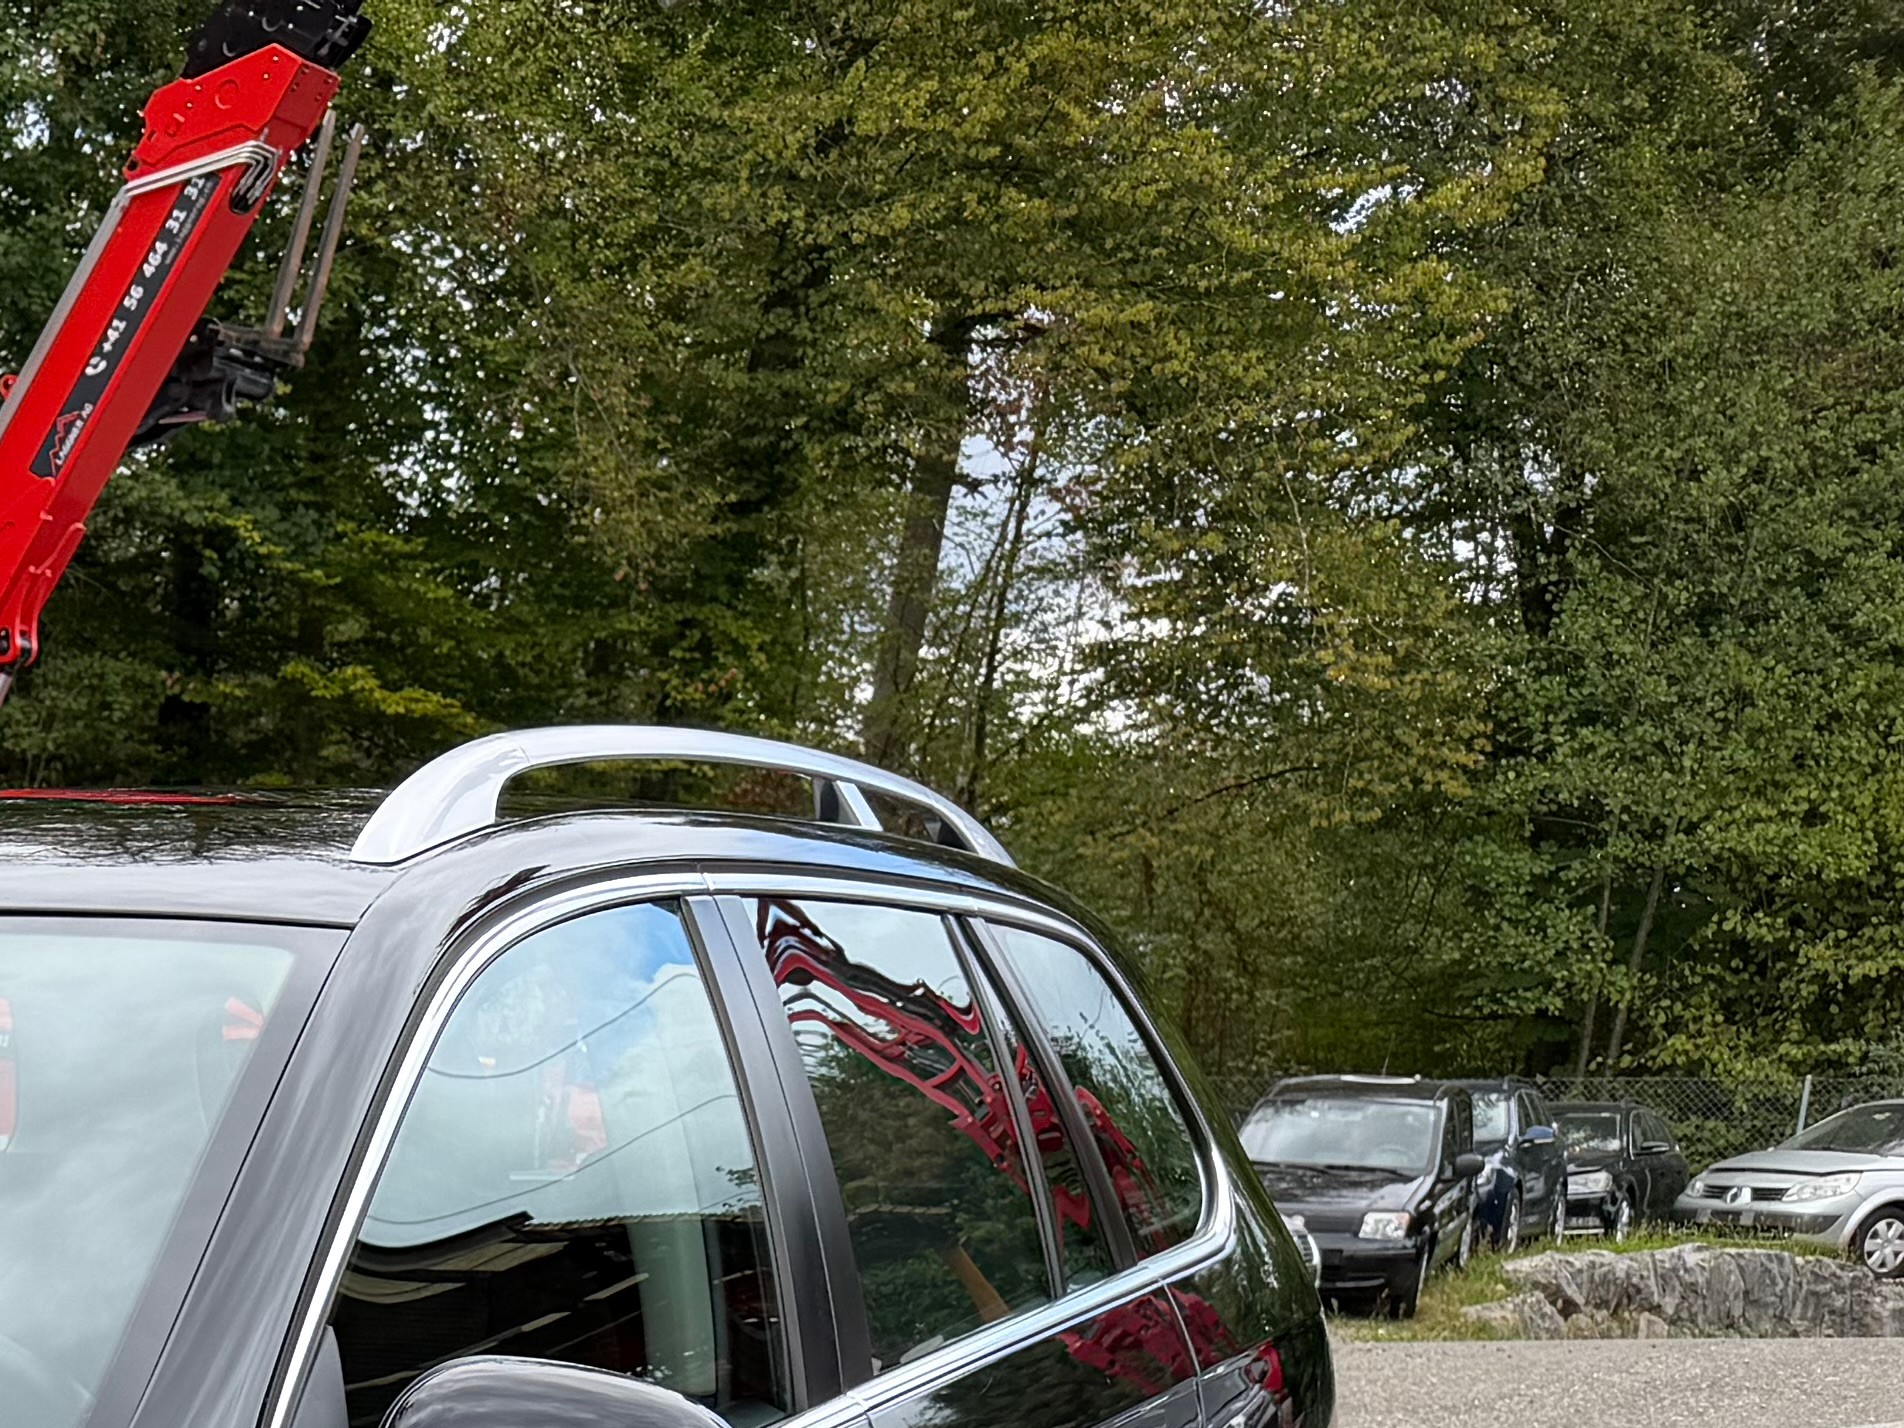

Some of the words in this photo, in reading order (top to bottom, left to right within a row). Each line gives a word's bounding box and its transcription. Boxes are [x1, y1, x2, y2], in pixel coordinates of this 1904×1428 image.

[103, 319, 127, 353] +41
[123, 284, 144, 311] 56
[142, 240, 168, 278] 464
[165, 208, 188, 234] 31
